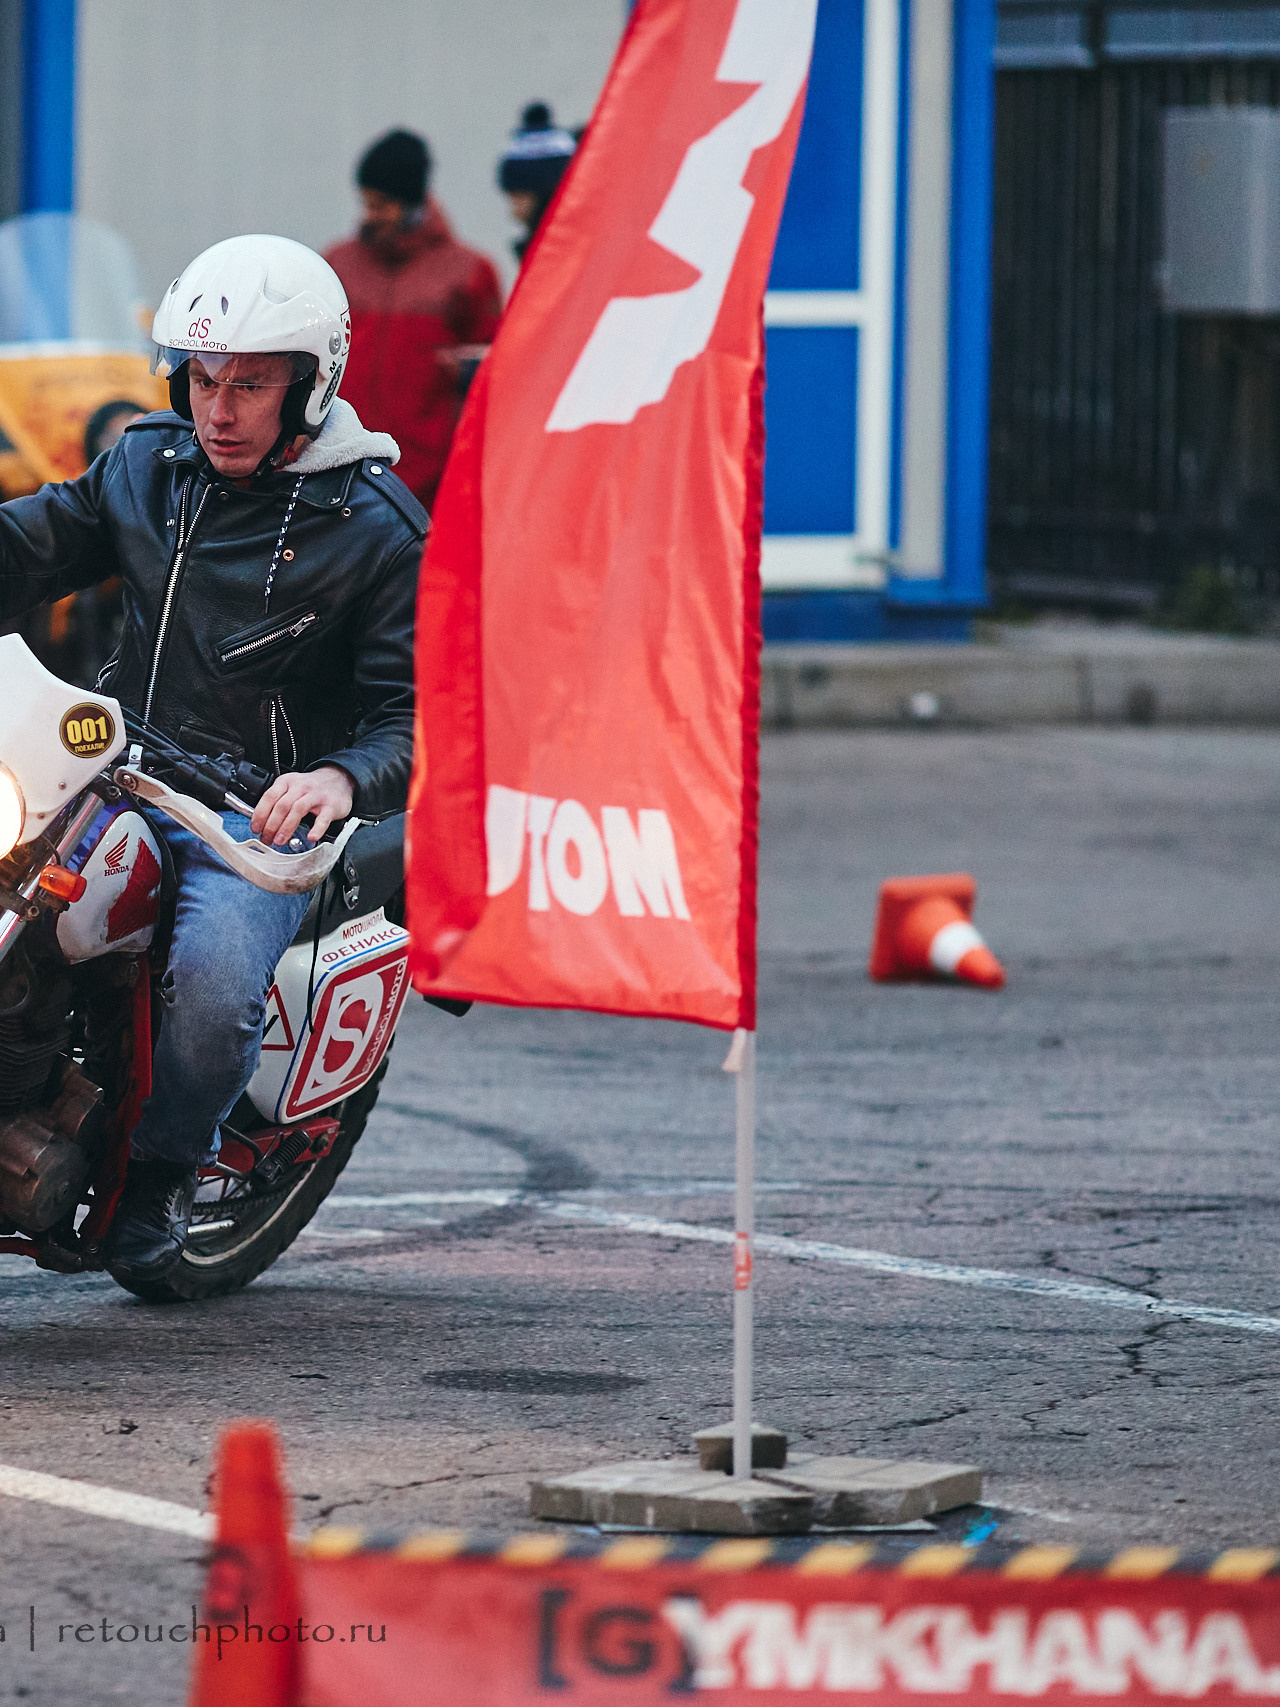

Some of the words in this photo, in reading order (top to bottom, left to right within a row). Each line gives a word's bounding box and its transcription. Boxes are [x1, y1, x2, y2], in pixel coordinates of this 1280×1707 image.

[66, 716, 108, 744] 001
[104, 865, 130, 876] HONDA
[321, 926, 403, 962] ФЕНИКС
